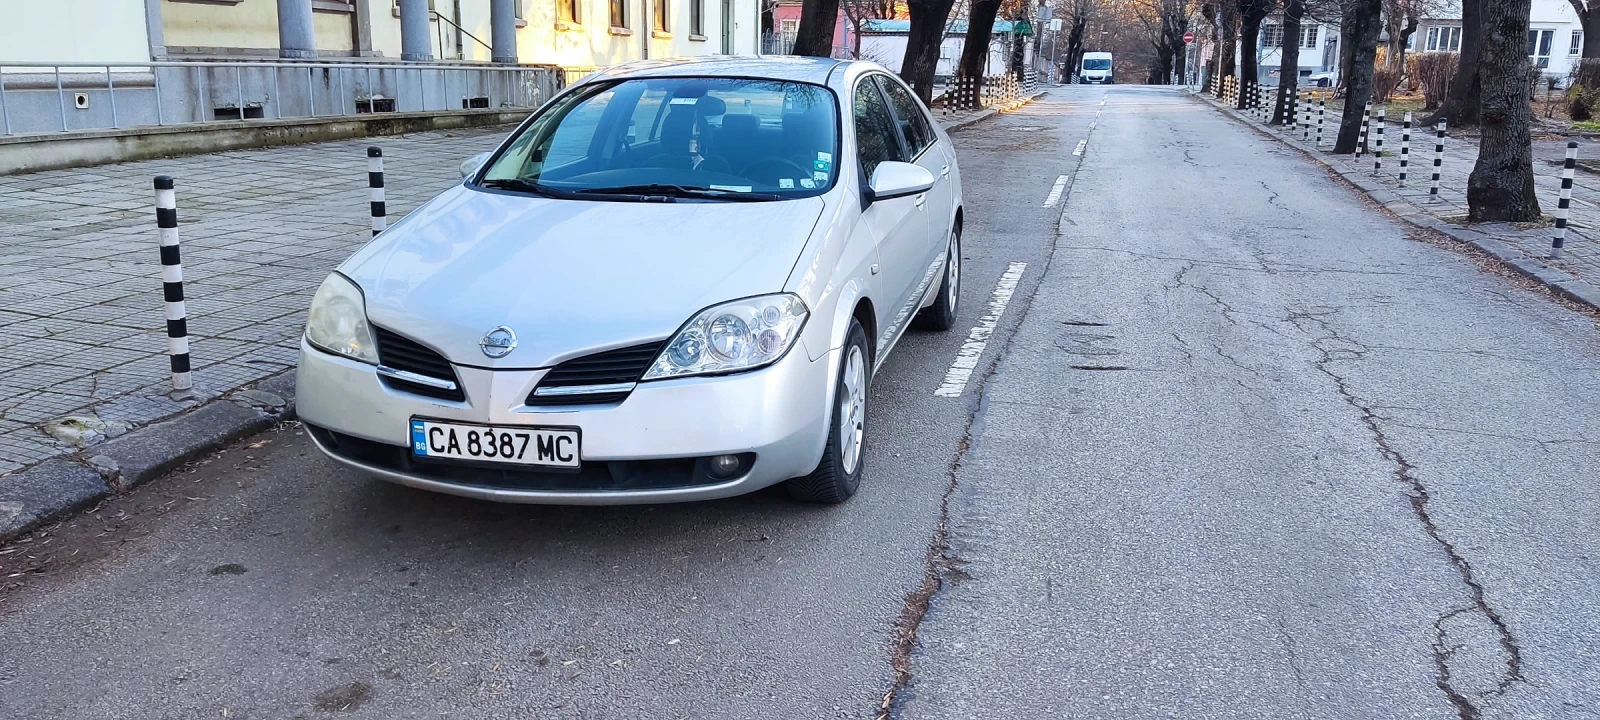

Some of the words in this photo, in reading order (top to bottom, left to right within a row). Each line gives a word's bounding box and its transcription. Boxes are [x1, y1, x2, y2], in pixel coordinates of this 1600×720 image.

[416, 443, 426, 451] BG
[429, 427, 462, 456] CA
[467, 430, 530, 460] 8387
[537, 434, 573, 462] MC
